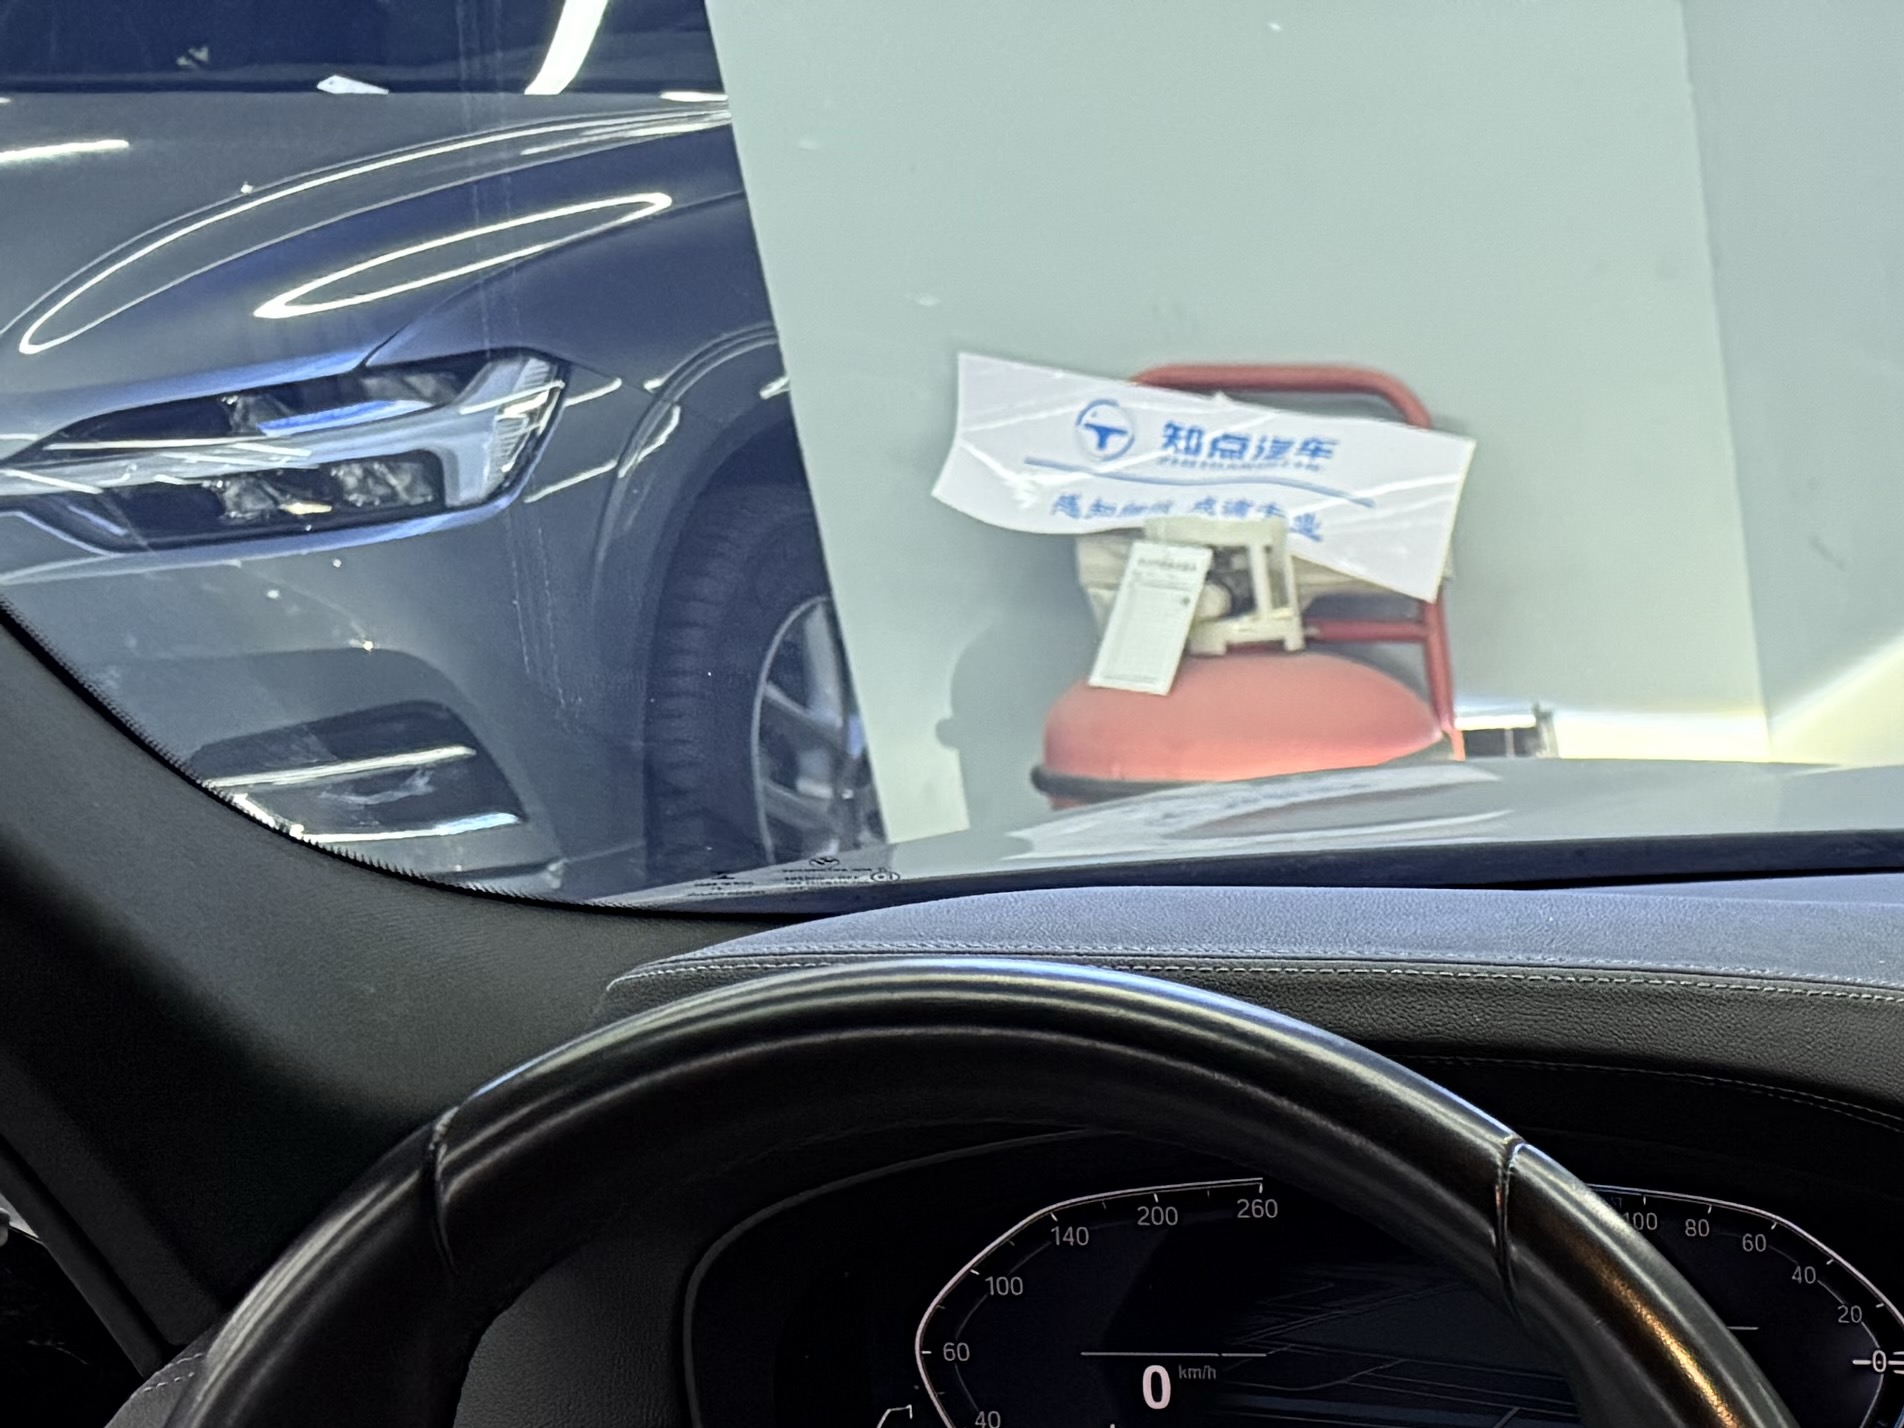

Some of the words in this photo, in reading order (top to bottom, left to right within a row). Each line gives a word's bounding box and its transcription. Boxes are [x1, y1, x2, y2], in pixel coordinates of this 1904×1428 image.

[1163, 420, 1339, 460] 知点汽车
[1136, 1206, 1179, 1226] 200
[1236, 1199, 1279, 1218] 260
[1050, 1226, 1090, 1247] 140
[1684, 1218, 1710, 1238] 80
[1741, 1234, 1767, 1253] 60
[1791, 1266, 1817, 1285] 40
[983, 1276, 1024, 1296] 100
[1837, 1305, 1863, 1324] 20
[942, 1342, 971, 1362] 60
[1141, 1364, 1172, 1411] 0
[1178, 1364, 1217, 1380] km/h
